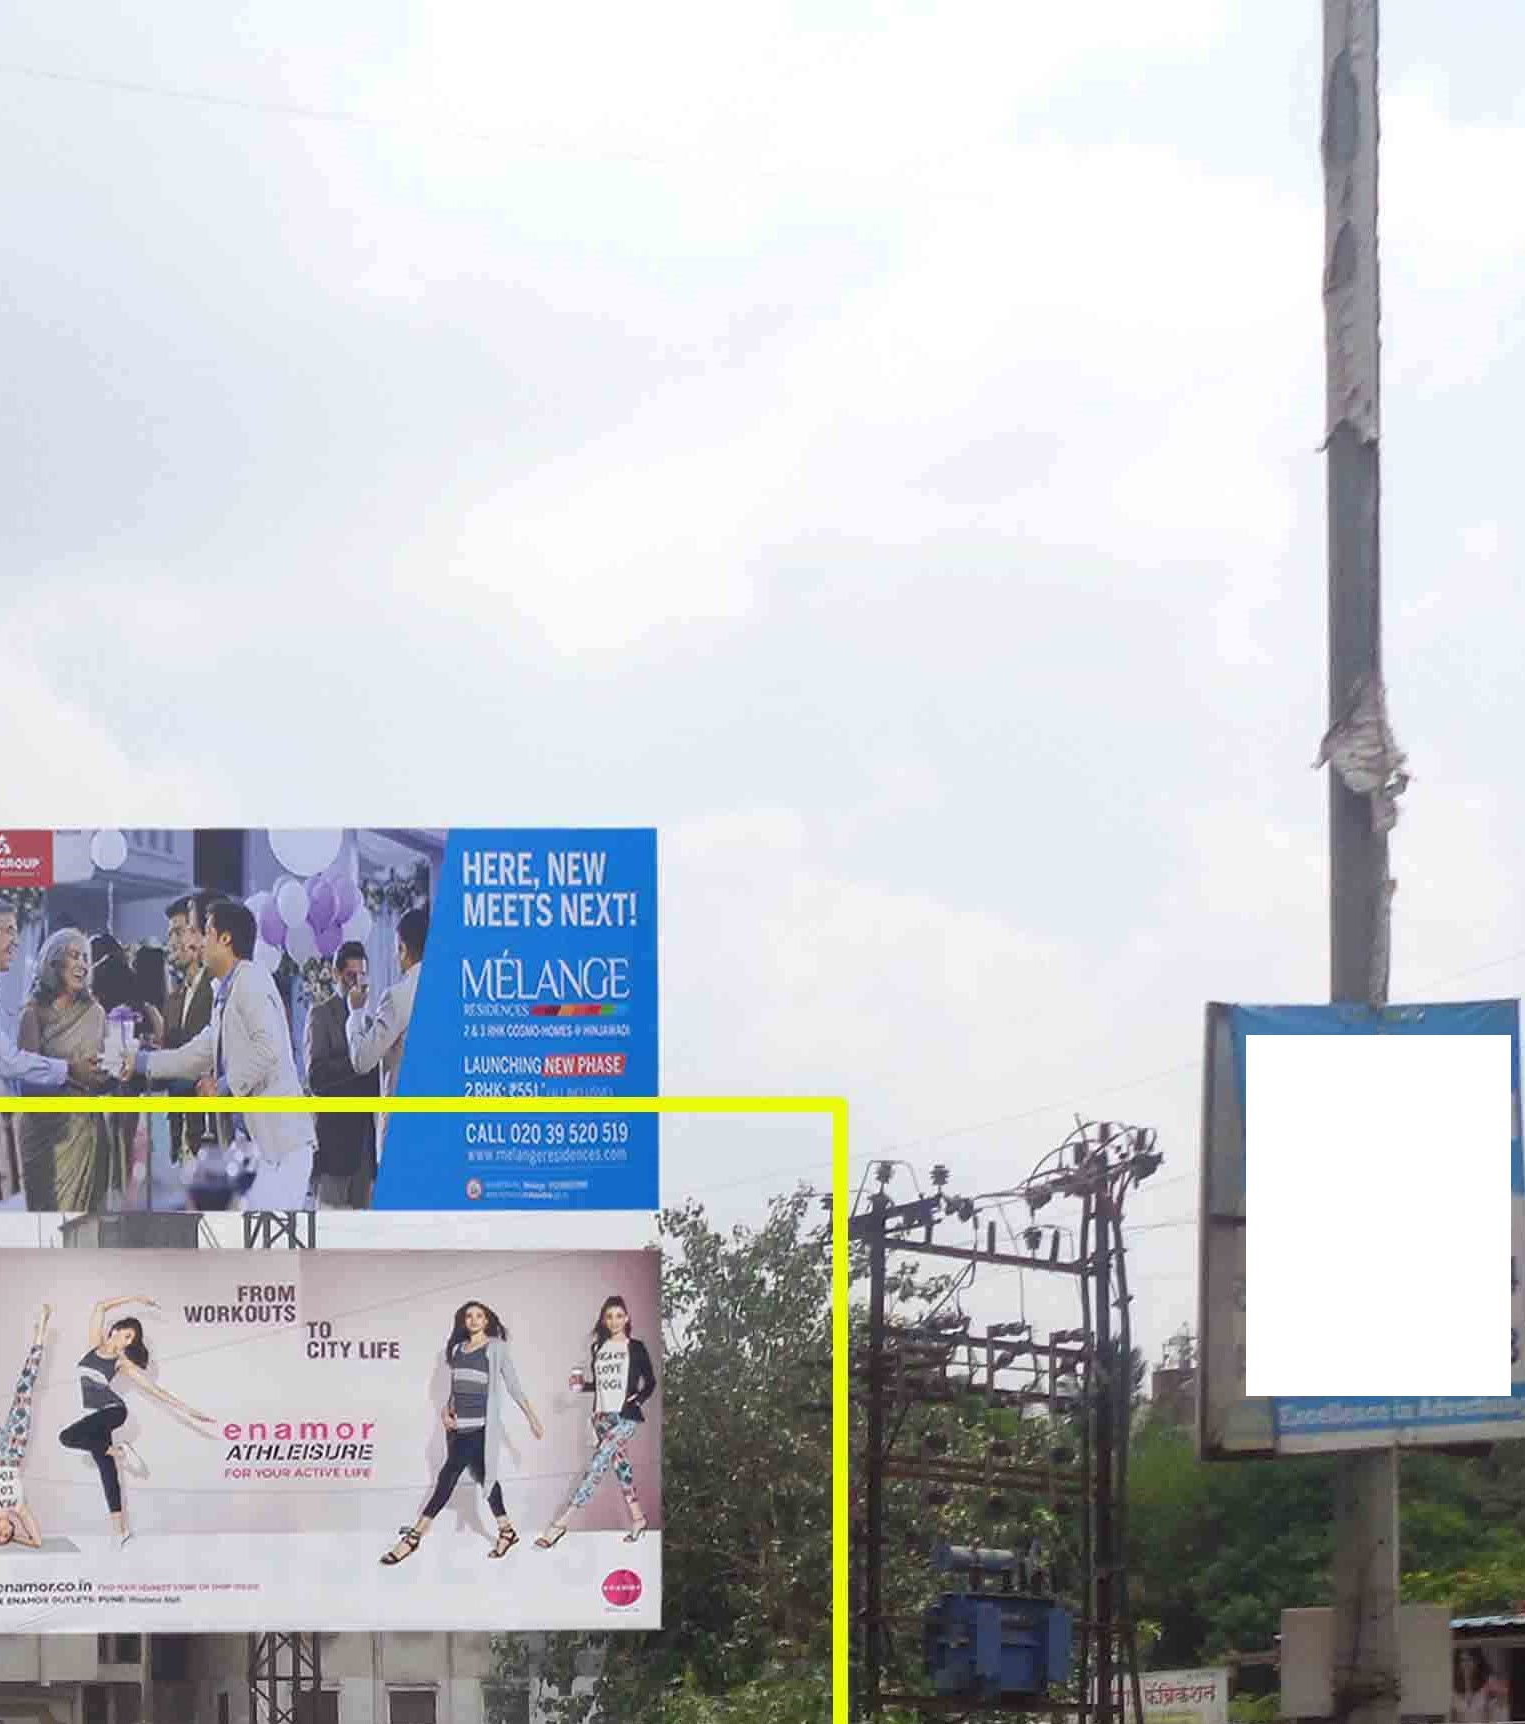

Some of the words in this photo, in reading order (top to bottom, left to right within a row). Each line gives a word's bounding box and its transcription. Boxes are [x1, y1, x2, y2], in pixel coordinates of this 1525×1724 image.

[462, 851, 540, 891] HERE,
[547, 851, 607, 887] NEW
[463, 892, 554, 928] MEETS
[560, 892, 637, 928] NEXT!
[462, 948, 631, 1001] MÉLANGE
[464, 1055, 542, 1074] LAUNCHING
[544, 1055, 574, 1074] NEW
[577, 1055, 621, 1074] PHASE
[465, 1123, 506, 1144] CALL
[510, 1122, 541, 1144] 020
[545, 1122, 565, 1144] 39
[568, 1122, 598, 1144] 520
[602, 1122, 629, 1143] 519
[237, 1285, 296, 1303] FROM
[184, 1304, 296, 1323] WORKOUTS
[306, 1320, 333, 1339] TO
[306, 1341, 352, 1360] CITY
[358, 1341, 401, 1360] LIFE
[224, 1421, 375, 1441] enamor
[225, 1443, 374, 1462] ATHLEISURE
[224, 1467, 252, 1479] FOR
[255, 1467, 291, 1479] YOUR
[294, 1467, 341, 1478] ACTIVE
[344, 1467, 373, 1478] LIFE
[7, 1597, 49, 1606] ENAMOR
